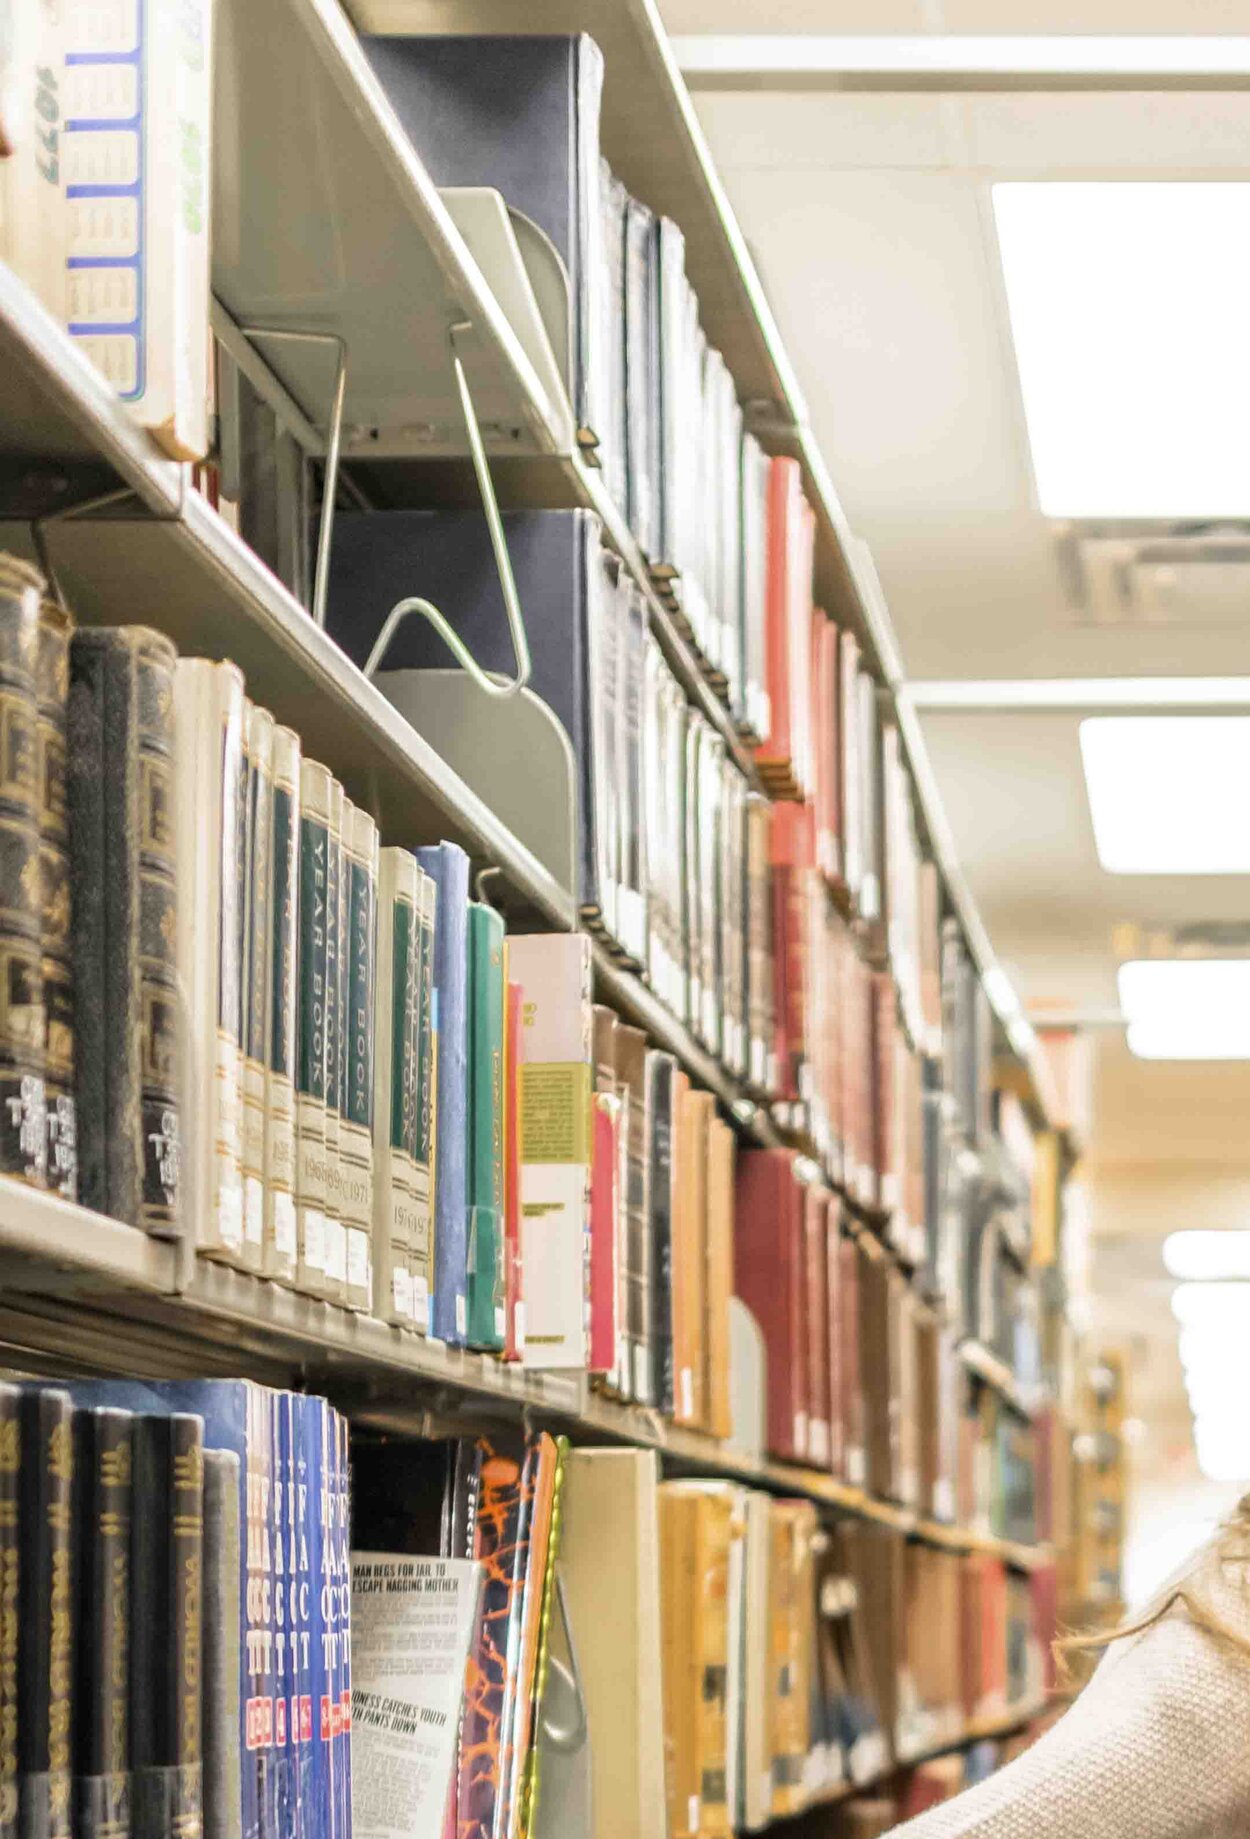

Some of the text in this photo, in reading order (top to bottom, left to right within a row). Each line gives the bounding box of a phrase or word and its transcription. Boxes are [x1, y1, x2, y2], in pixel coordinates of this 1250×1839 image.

[312, 842, 323, 1085] YEAR BOOK
[356, 886, 368, 1112] YEAR BOOK
[353, 1564, 372, 1577] MAN
[373, 1564, 396, 1577] BEGS
[397, 1564, 415, 1577] FOR
[436, 1564, 447, 1577] TO
[352, 1579, 383, 1594] ESCAPE
[424, 1579, 459, 1593] MOTHER
[364, 1709, 390, 1729] PANTS
[391, 1717, 417, 1736] DOWN
[381, 1698, 418, 1720] CATCHES
[419, 1707, 448, 1727] YOUTH
